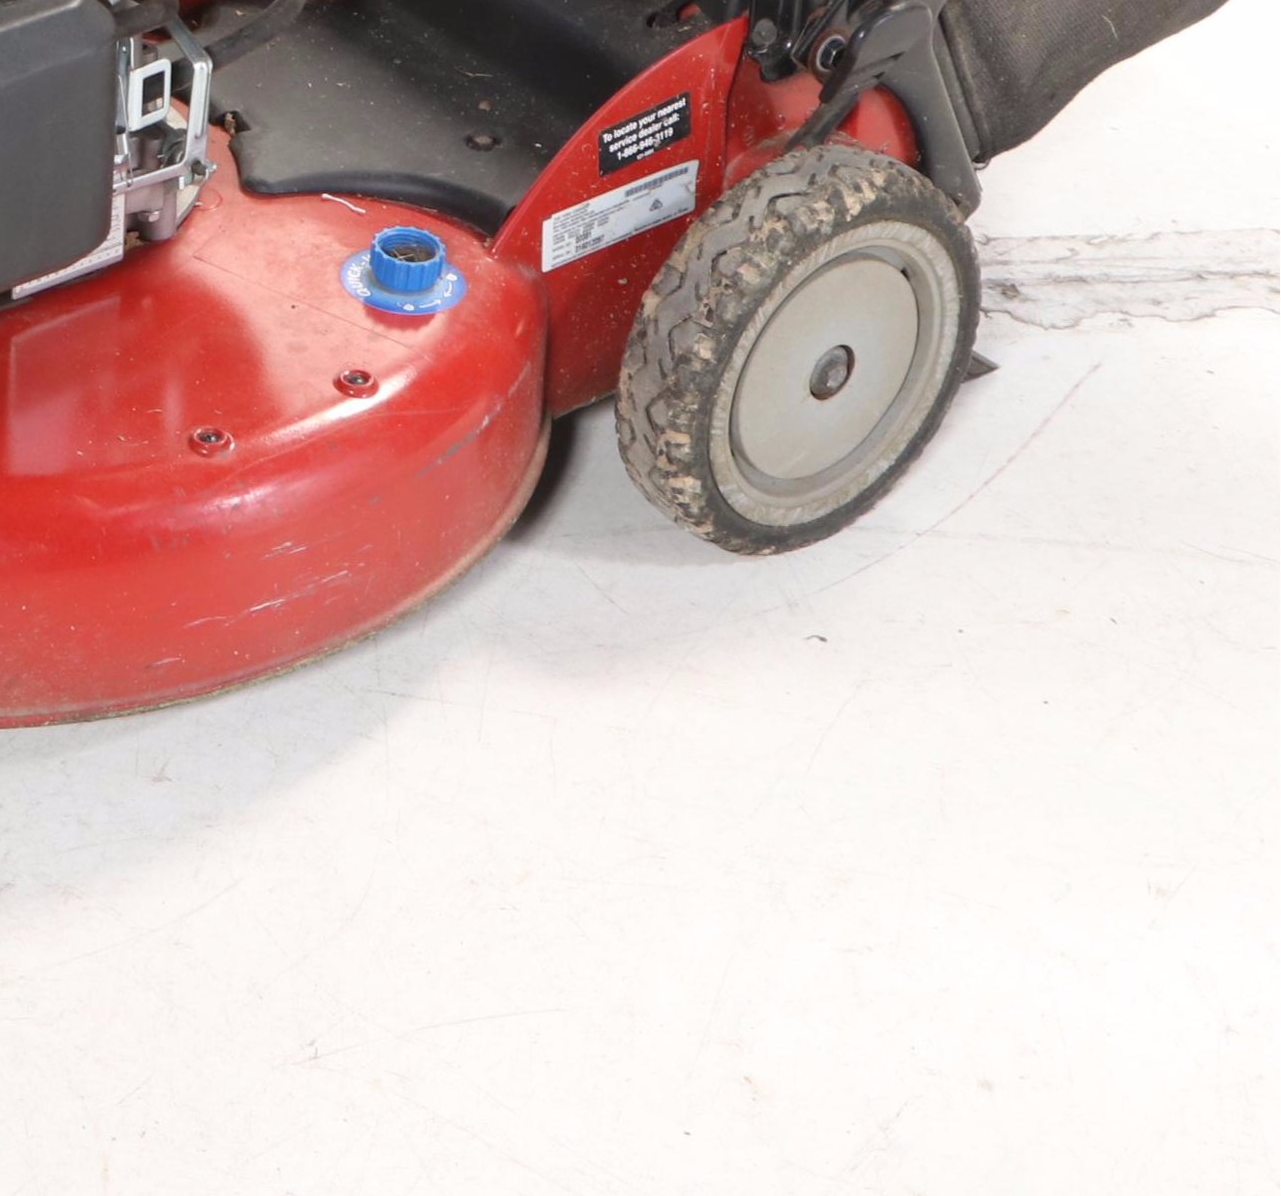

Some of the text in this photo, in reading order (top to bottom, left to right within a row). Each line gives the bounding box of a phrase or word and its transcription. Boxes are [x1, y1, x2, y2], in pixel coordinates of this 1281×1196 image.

[603, 97, 686, 144] To locate your nearest
[609, 134, 638, 153] service
[638, 121, 663, 139] dealer
